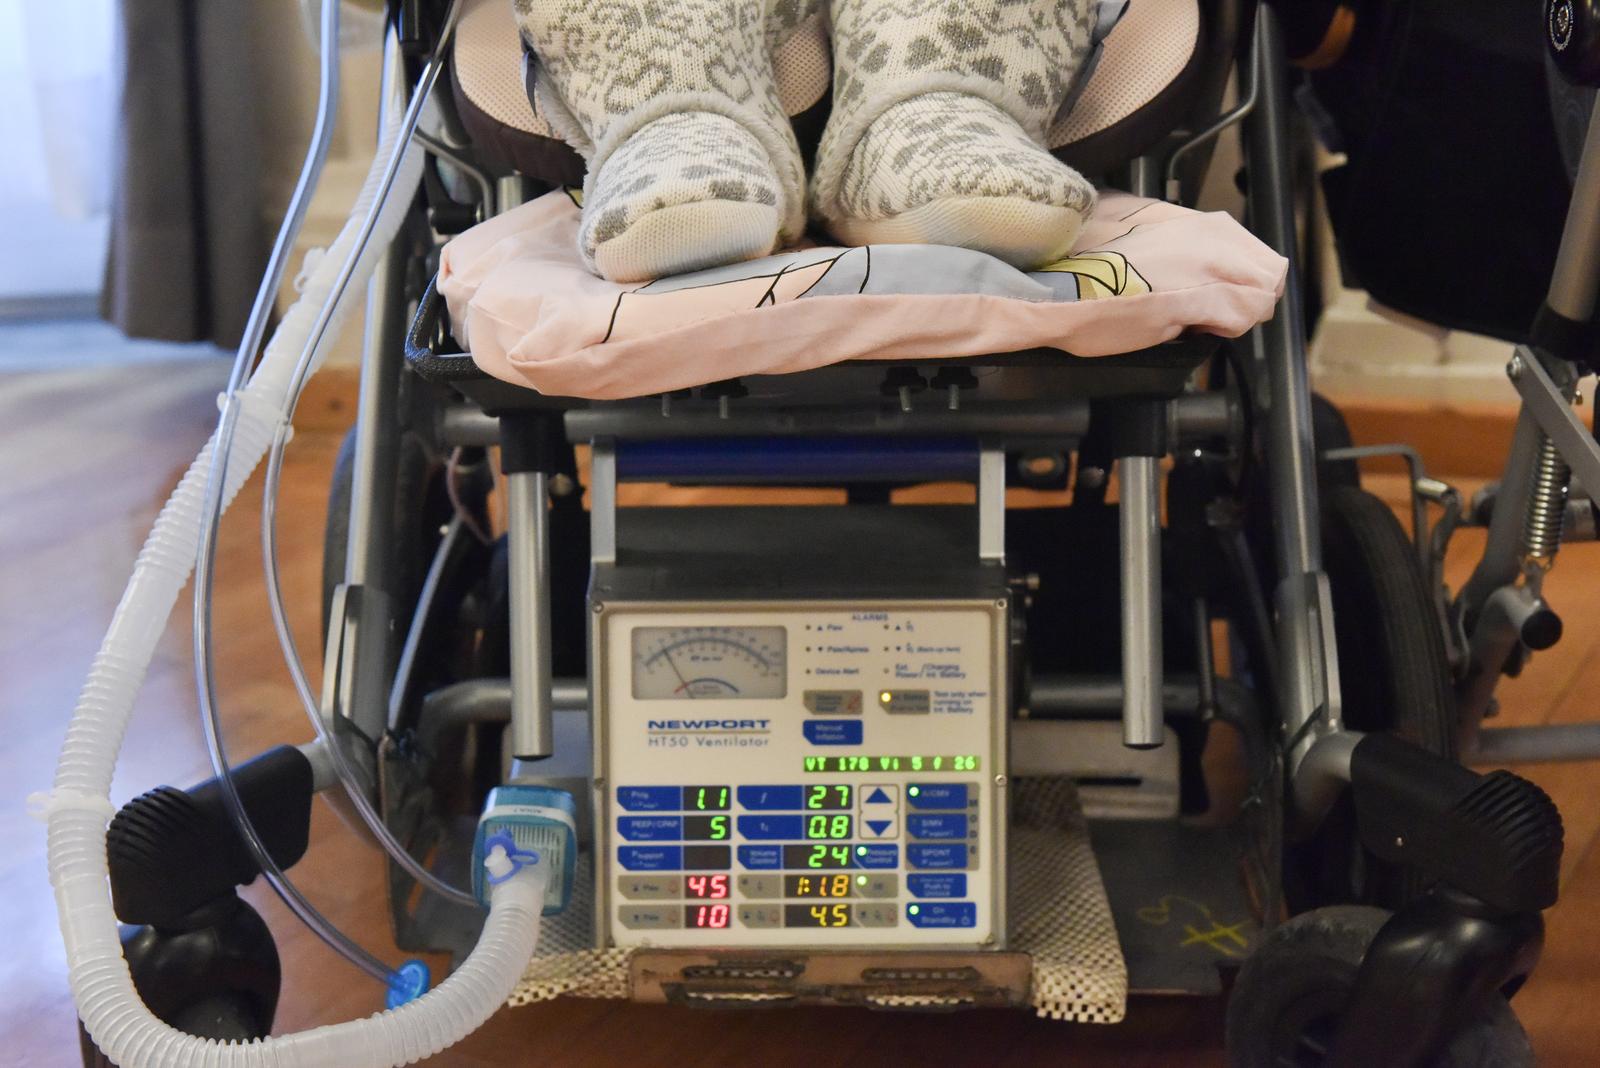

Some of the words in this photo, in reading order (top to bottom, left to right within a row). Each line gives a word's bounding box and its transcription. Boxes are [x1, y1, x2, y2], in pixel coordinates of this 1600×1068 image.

[648, 720, 771, 729] NEWPORT
[648, 736, 689, 748] HT50
[696, 736, 769, 748] Ventilator
[954, 756, 976, 770] 26
[808, 786, 849, 808] 27
[710, 816, 726, 840] 5
[808, 845, 848, 868] 24
[688, 874, 728, 898] 45
[697, 904, 729, 928] 10
